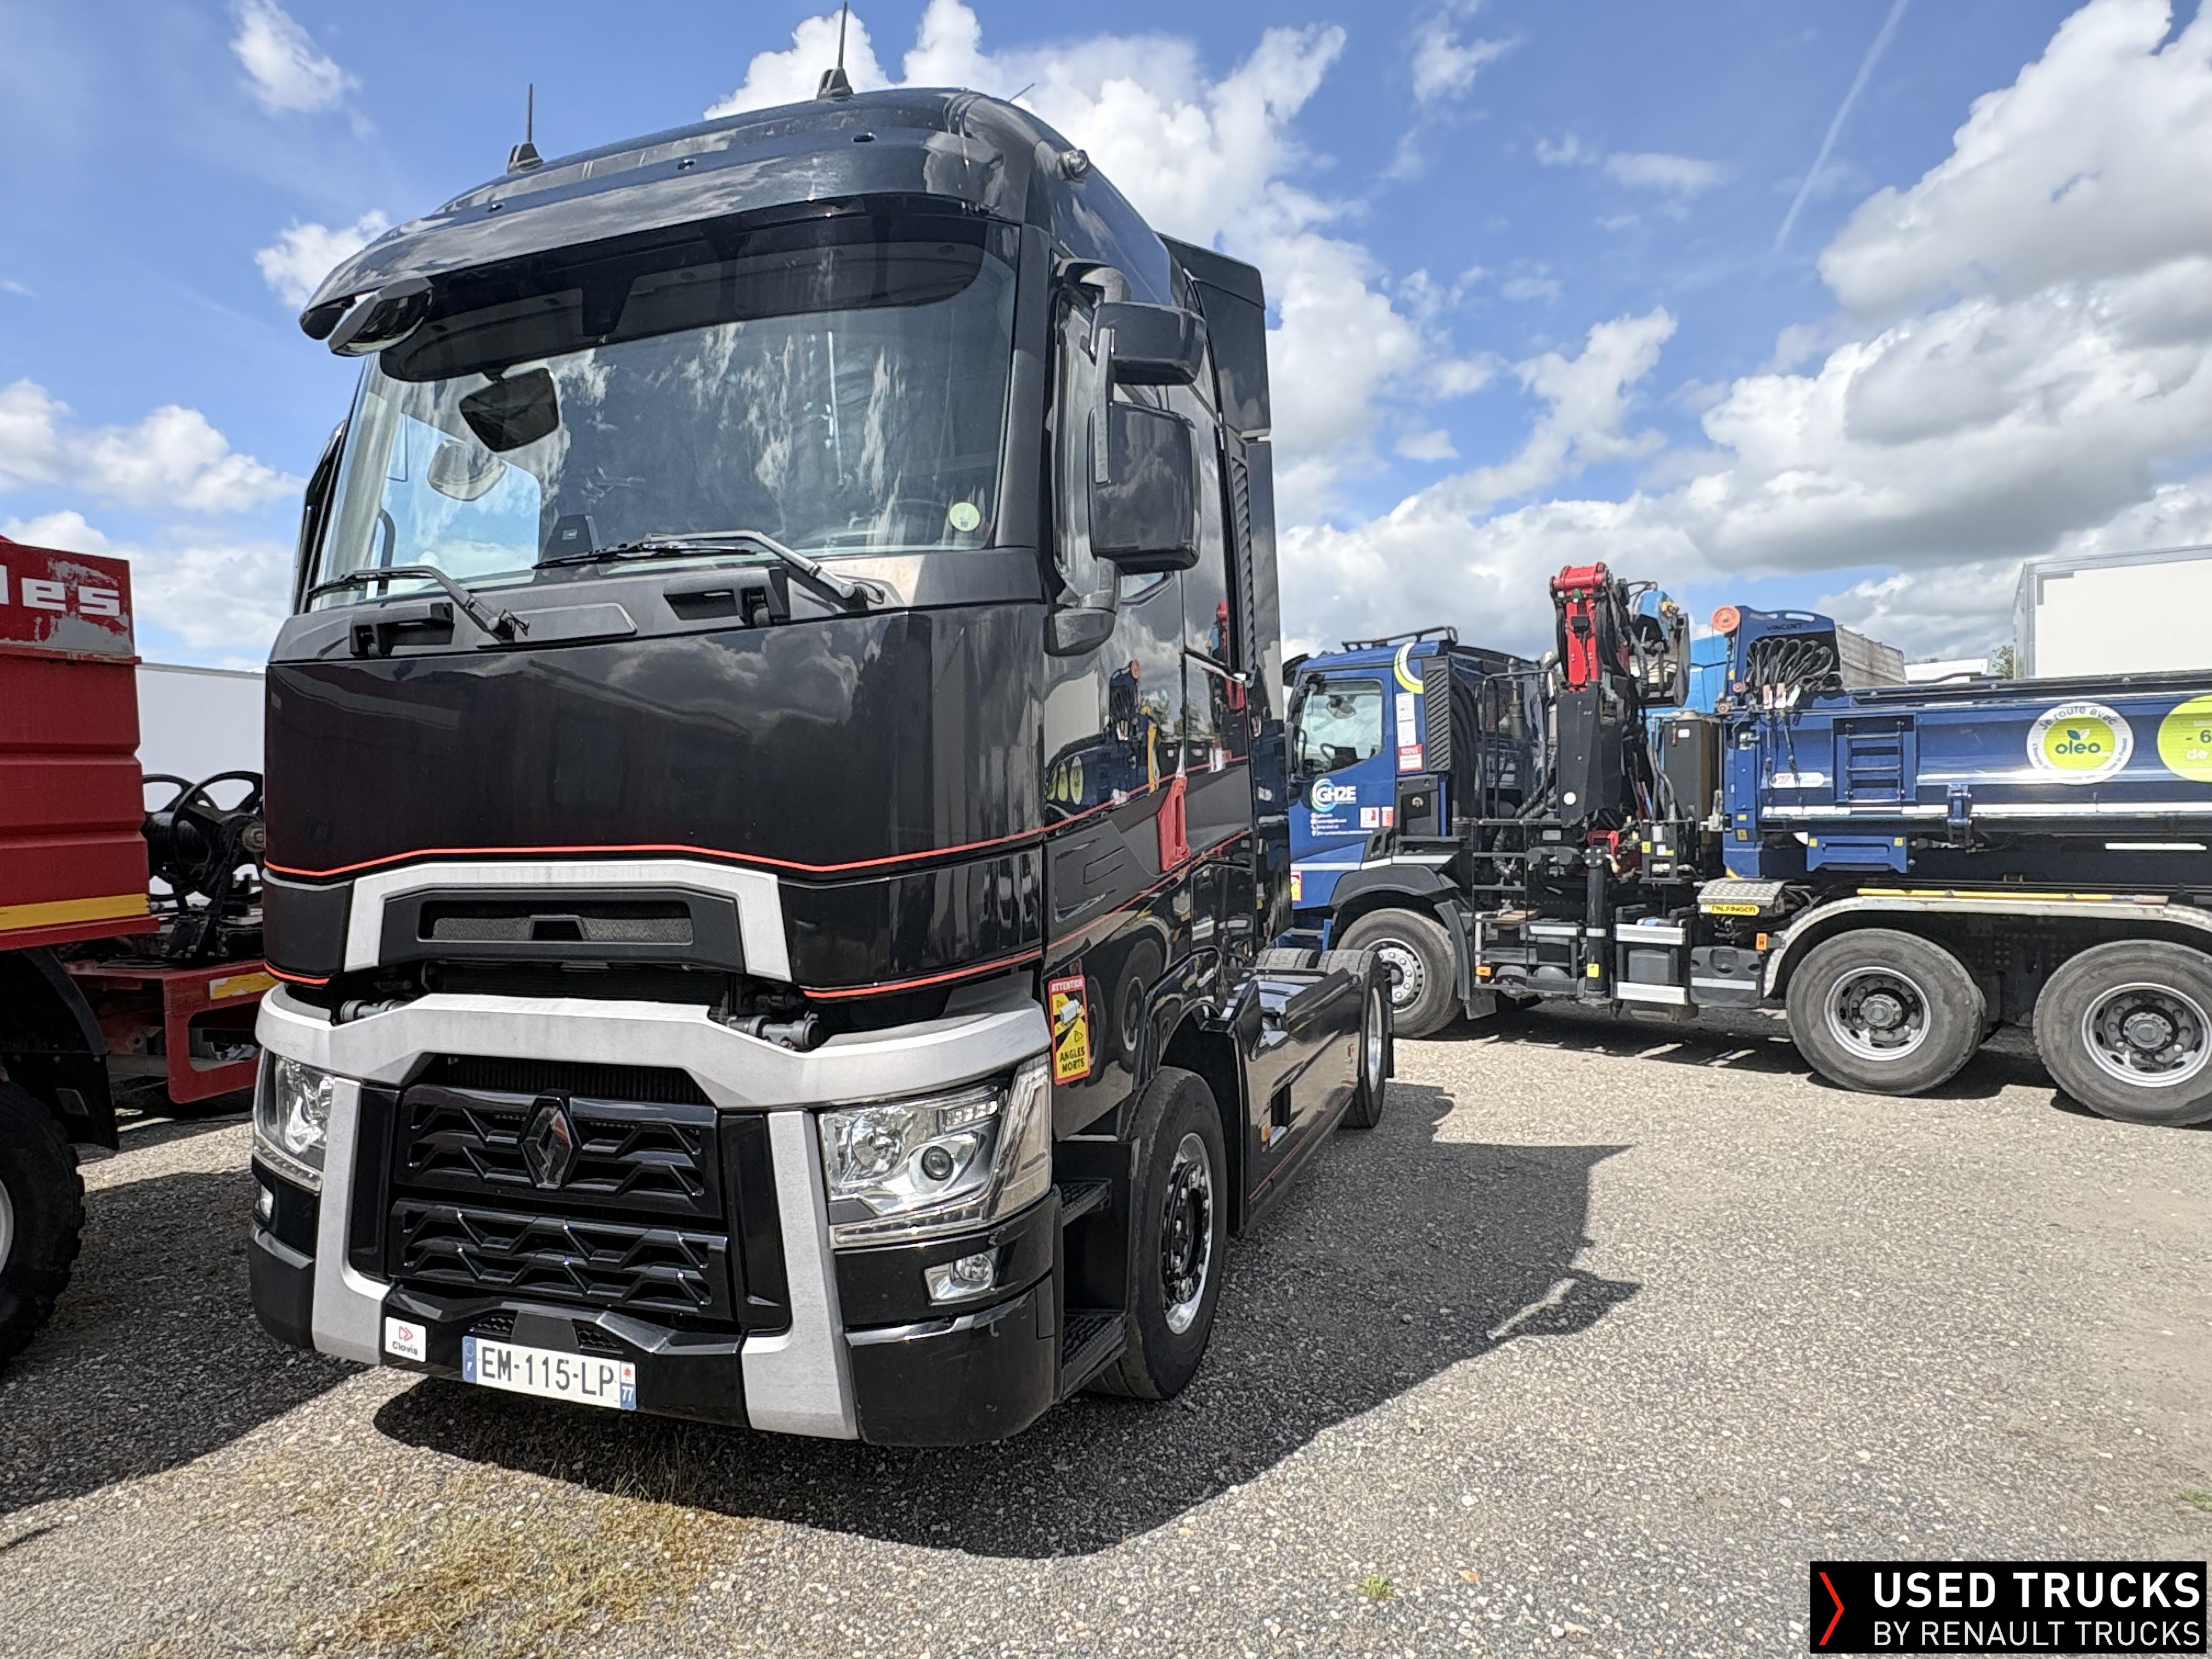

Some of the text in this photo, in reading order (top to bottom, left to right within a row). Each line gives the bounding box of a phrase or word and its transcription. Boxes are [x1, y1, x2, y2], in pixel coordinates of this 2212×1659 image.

[2053, 706, 2086, 720] route
[2090, 709, 2117, 725] avec
[2055, 740, 2101, 755] oleo
[1316, 786, 1356, 802] GH2E
[1059, 1046, 1085, 1063] ANGLES
[1062, 1058, 1085, 1073] MORTS
[392, 1341, 418, 1356] Clovis
[482, 1346, 614, 1397] EM-115-LP
[622, 1386, 634, 1402] 77
